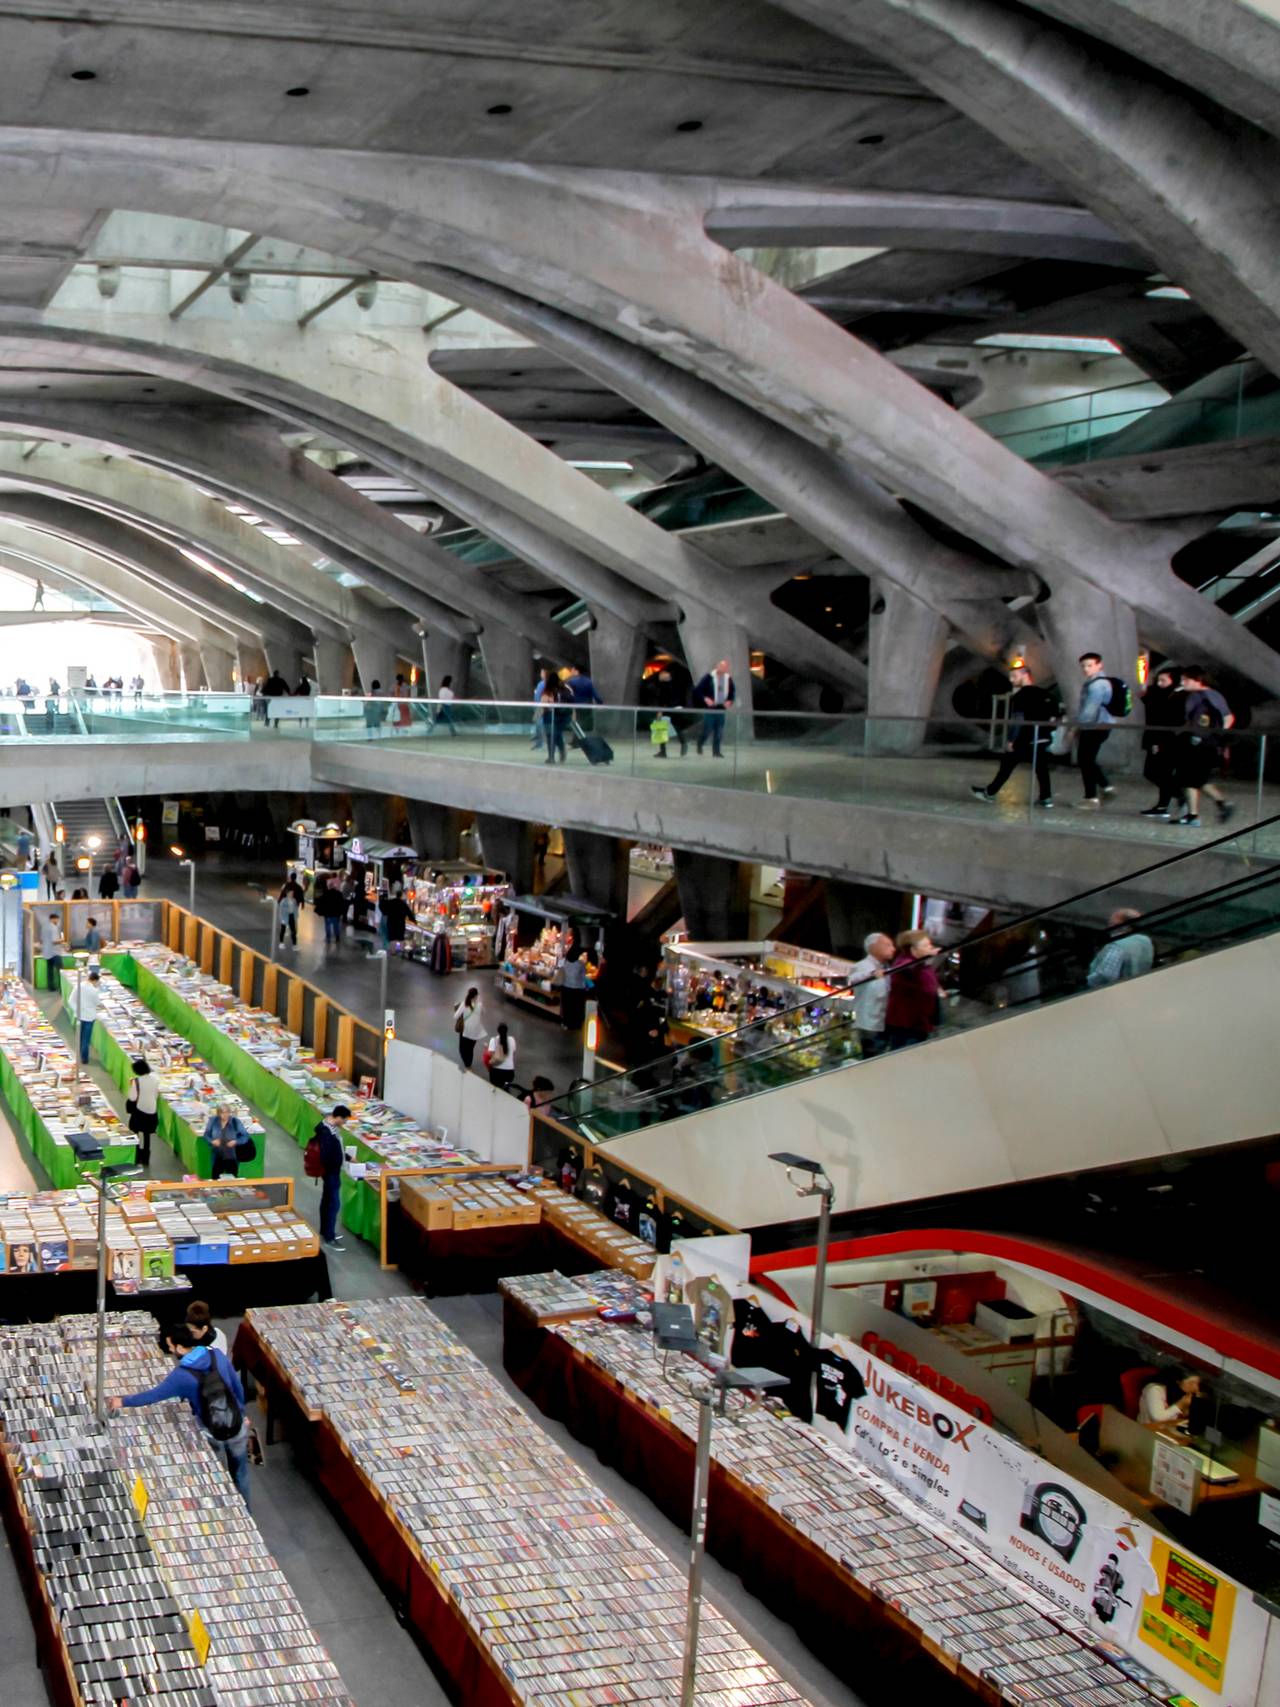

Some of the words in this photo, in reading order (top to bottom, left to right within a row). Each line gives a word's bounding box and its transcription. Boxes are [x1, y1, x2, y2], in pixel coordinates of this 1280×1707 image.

[864, 1359, 977, 1453] JUKEBOX
[856, 1406, 900, 1442] COMPRA
[903, 1435, 911, 1449] E
[912, 1442, 950, 1476] VENDA
[901, 1459, 909, 1469] e
[911, 1463, 950, 1498] Singles
[1008, 1535, 1040, 1562] NOVOS
[1041, 1556, 1049, 1567] E
[1048, 1561, 1087, 1593] USADOS
[1023, 1570, 1036, 1585] 21
[1037, 1580, 1057, 1599] 238
[1058, 1594, 1071, 1610] 52
